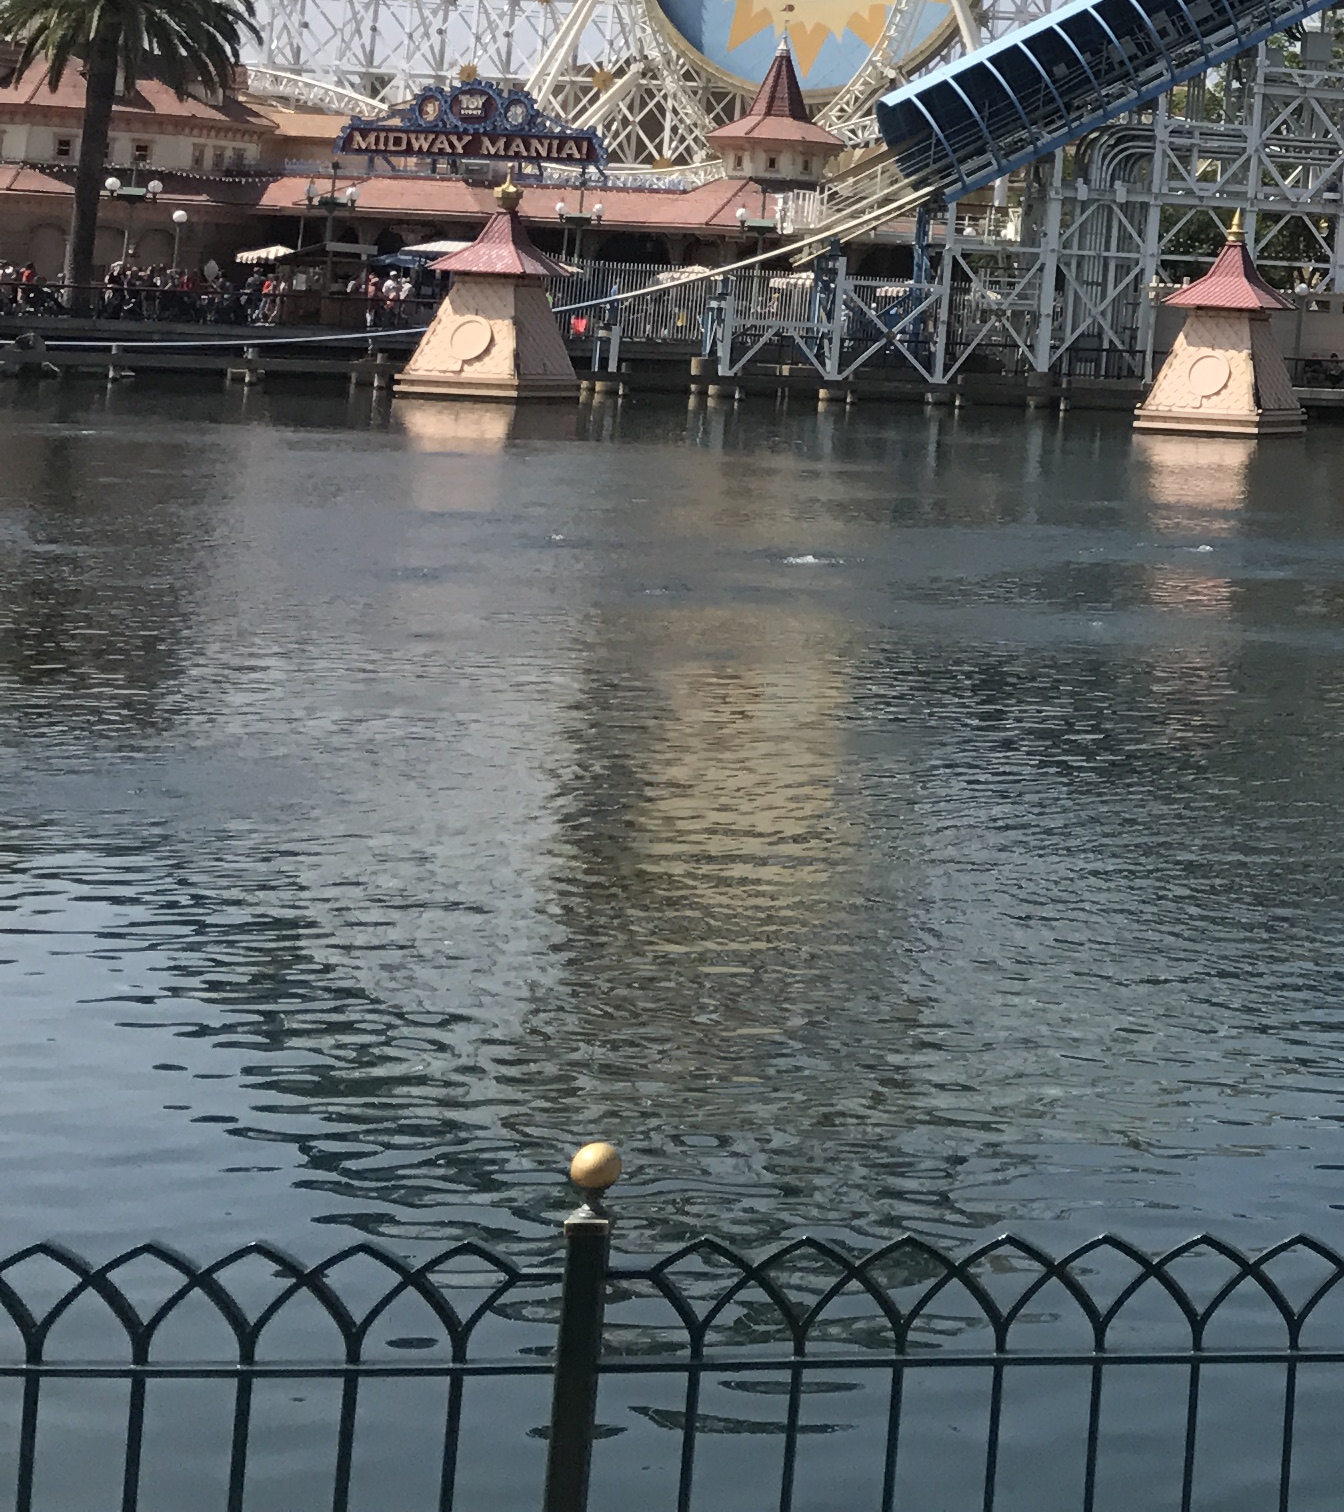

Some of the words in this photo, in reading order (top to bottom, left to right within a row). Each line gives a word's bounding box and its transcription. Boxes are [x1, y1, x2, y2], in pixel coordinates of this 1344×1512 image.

[459, 94, 488, 108] TOY
[350, 130, 472, 154] MIDWAY
[480, 135, 588, 159] MANIA!
